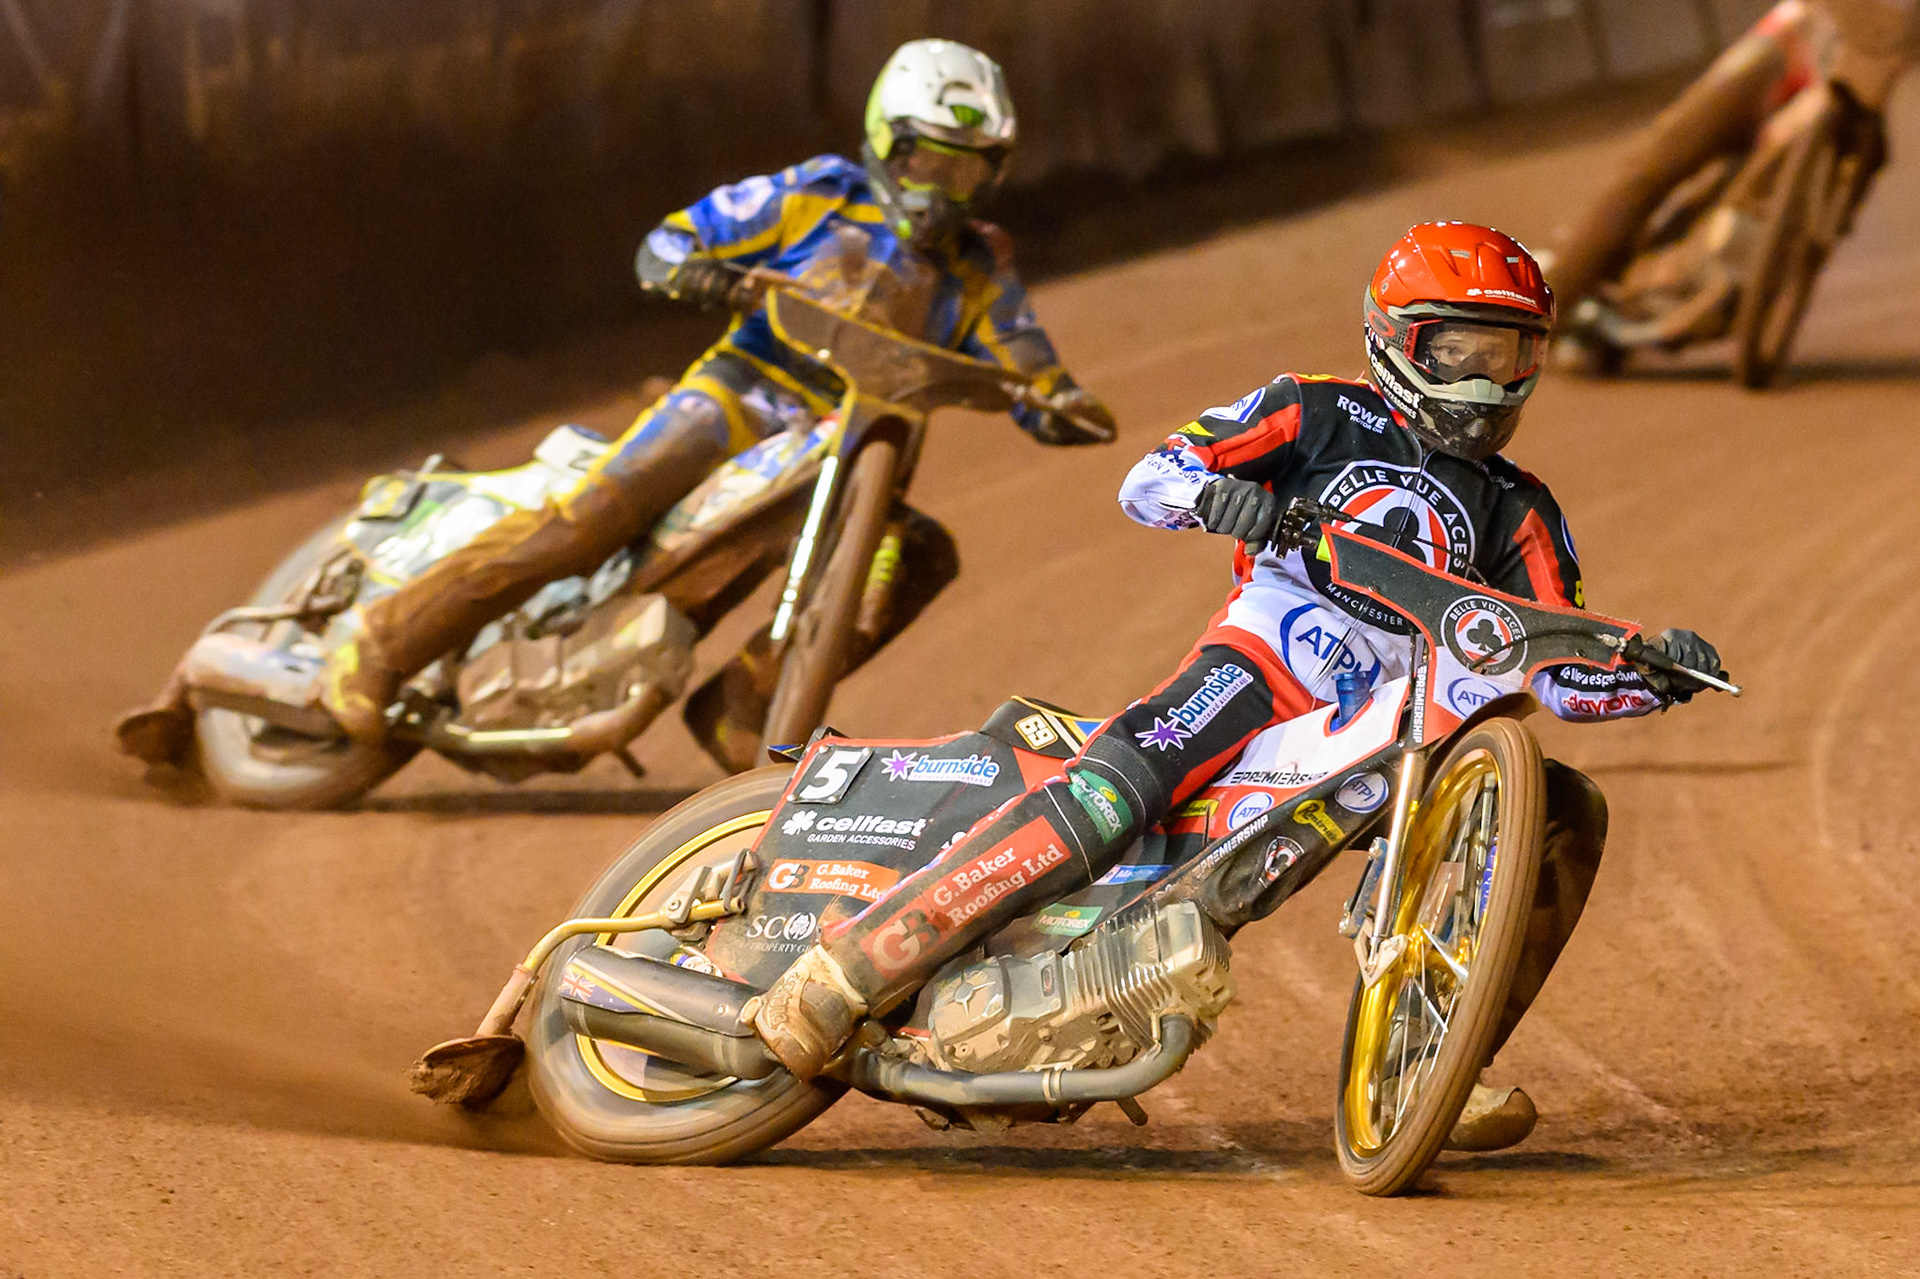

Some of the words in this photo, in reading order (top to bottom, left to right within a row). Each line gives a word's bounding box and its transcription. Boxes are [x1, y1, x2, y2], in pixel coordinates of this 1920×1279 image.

[1336, 394, 1388, 430] ROWE
[1350, 415, 1372, 430] MOTOR
[1329, 469, 1389, 508] BELLE
[1399, 474, 1443, 506] VUE
[1443, 512, 1468, 570] ACES
[1325, 582, 1404, 626] MANCHESTER
[1449, 600, 1478, 622] BELLE
[1481, 601, 1503, 616] VUE
[1503, 615, 1523, 641] ACES
[1170, 665, 1244, 726] burnside
[1412, 666, 1427, 743] PREMIERSHIP
[1016, 716, 1057, 748] 69
[799, 750, 863, 800] 5
[913, 757, 997, 778] burnside
[1071, 774, 1122, 834] MOTOREX
[1348, 780, 1376, 802] ATPI
[807, 833, 846, 843] GARDEN
[847, 835, 916, 851] ACCESSORIES
[816, 815, 926, 837] cellfast
[1192, 814, 1269, 873] PREMIERSHIP
[808, 878, 859, 896] Roofing
[816, 864, 870, 879] G.Baker
[933, 846, 1017, 907] G.Baker
[946, 869, 1026, 928] Roofing
[1021, 843, 1063, 877] Ltd
[750, 942, 797, 953] PROPERTY
